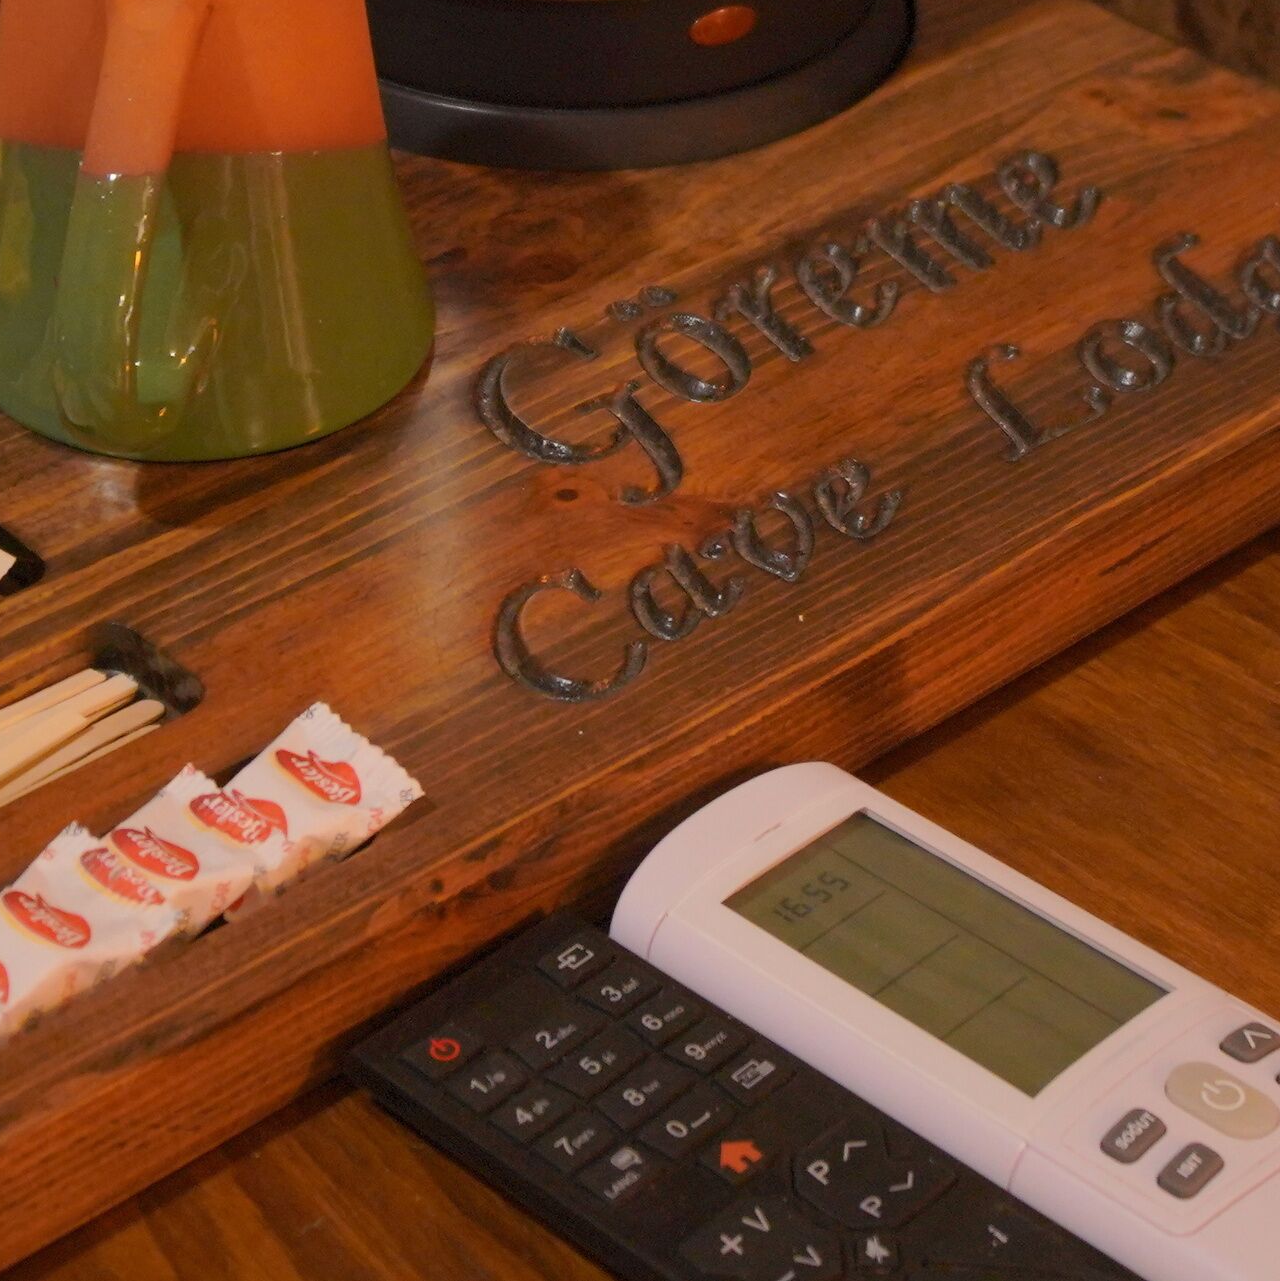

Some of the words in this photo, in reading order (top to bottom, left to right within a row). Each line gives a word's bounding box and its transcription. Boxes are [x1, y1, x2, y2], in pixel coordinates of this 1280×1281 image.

[474, 148, 1102, 507] Göreme
[492, 458, 906, 702] Cave
[291, 756, 356, 803] Besler
[202, 796, 268, 842] Besler
[600, 984, 623, 1002] 3
[641, 1013, 664, 1031] 6
[534, 1030, 559, 1050] 2
[684, 1043, 707, 1061] 9
[579, 1056, 602, 1075] 5
[622, 1087, 646, 1107] 8
[515, 1107, 534, 1125] 4
[665, 1119, 689, 1139] 0
[553, 1136, 575, 1156] 7
[807, 1158, 830, 1185] P
[859, 1194, 883, 1219] P
